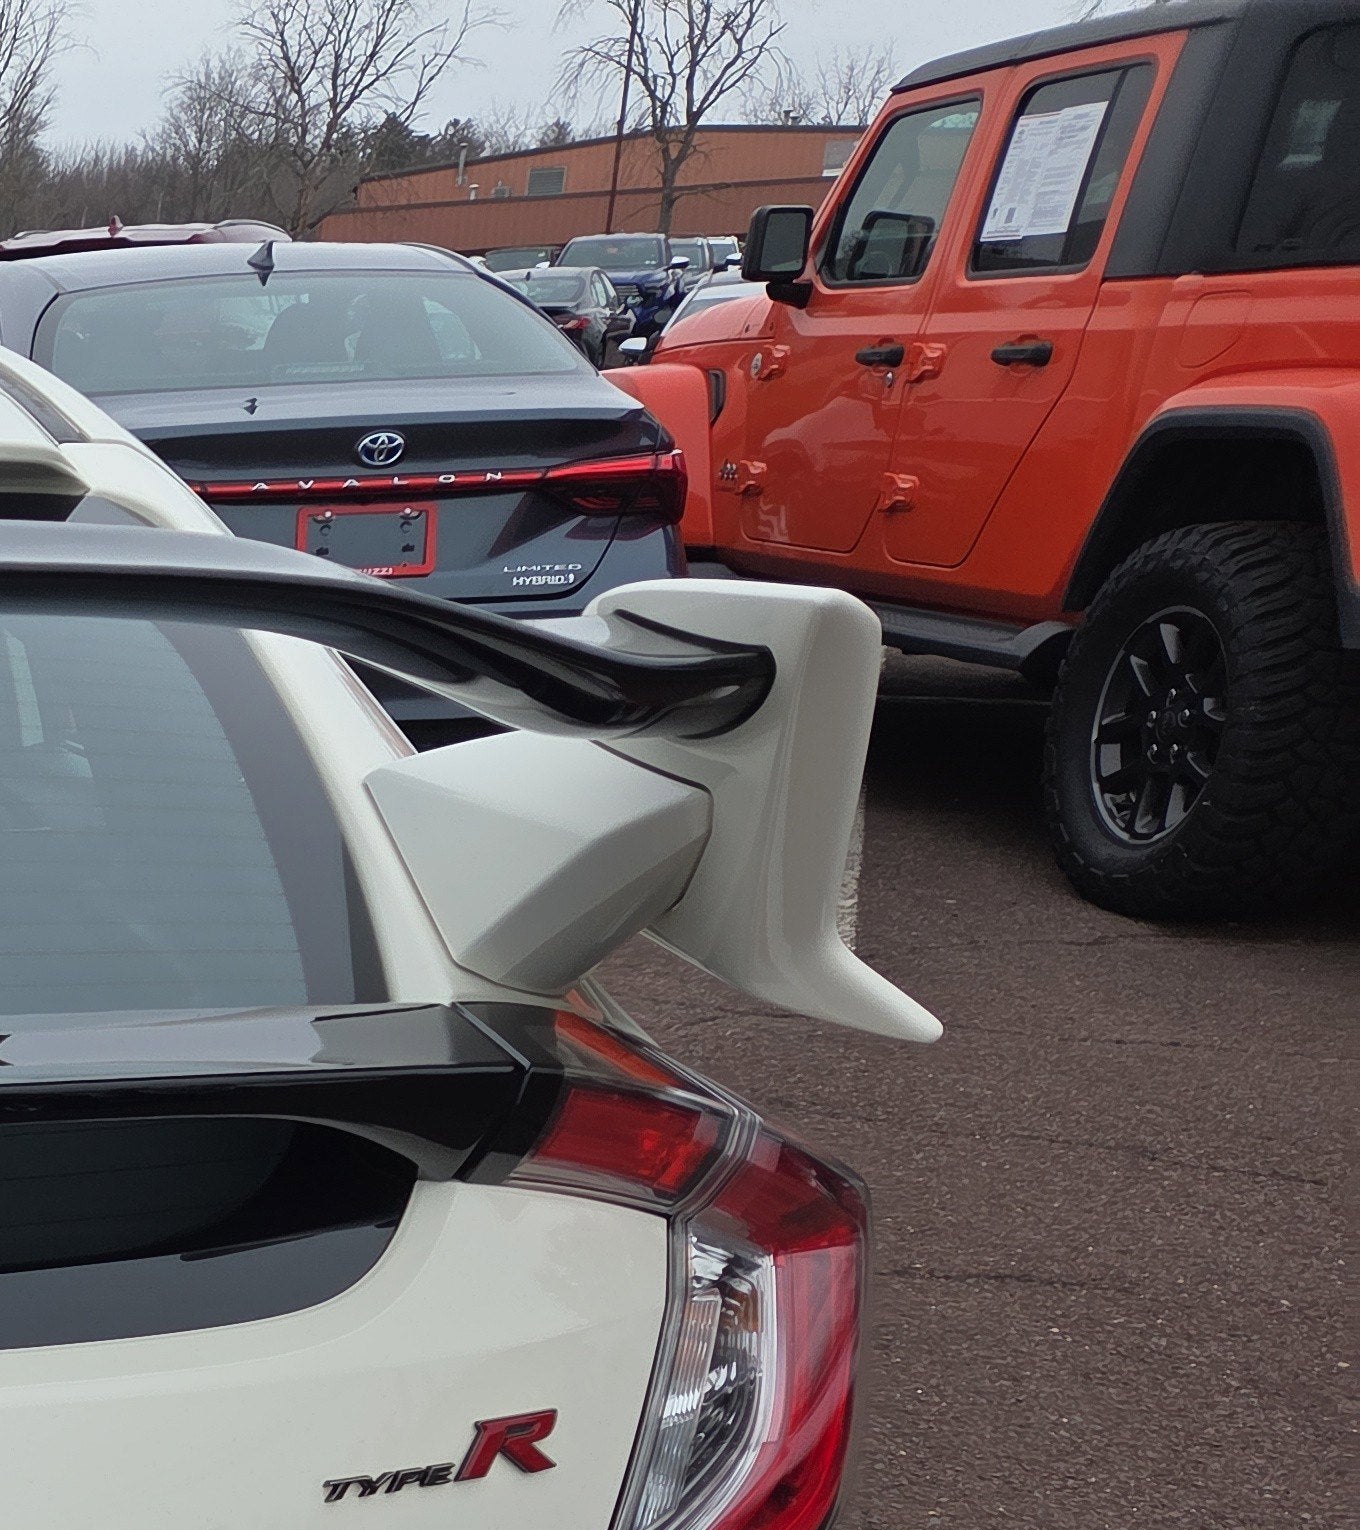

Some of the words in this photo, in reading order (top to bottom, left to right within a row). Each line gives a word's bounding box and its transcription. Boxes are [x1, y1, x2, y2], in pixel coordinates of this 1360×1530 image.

[251, 471, 502, 491] AVALON
[503, 563, 582, 573] LIMITED
[323, 1462, 456, 1503] TYPE
[453, 1408, 558, 1482] R
